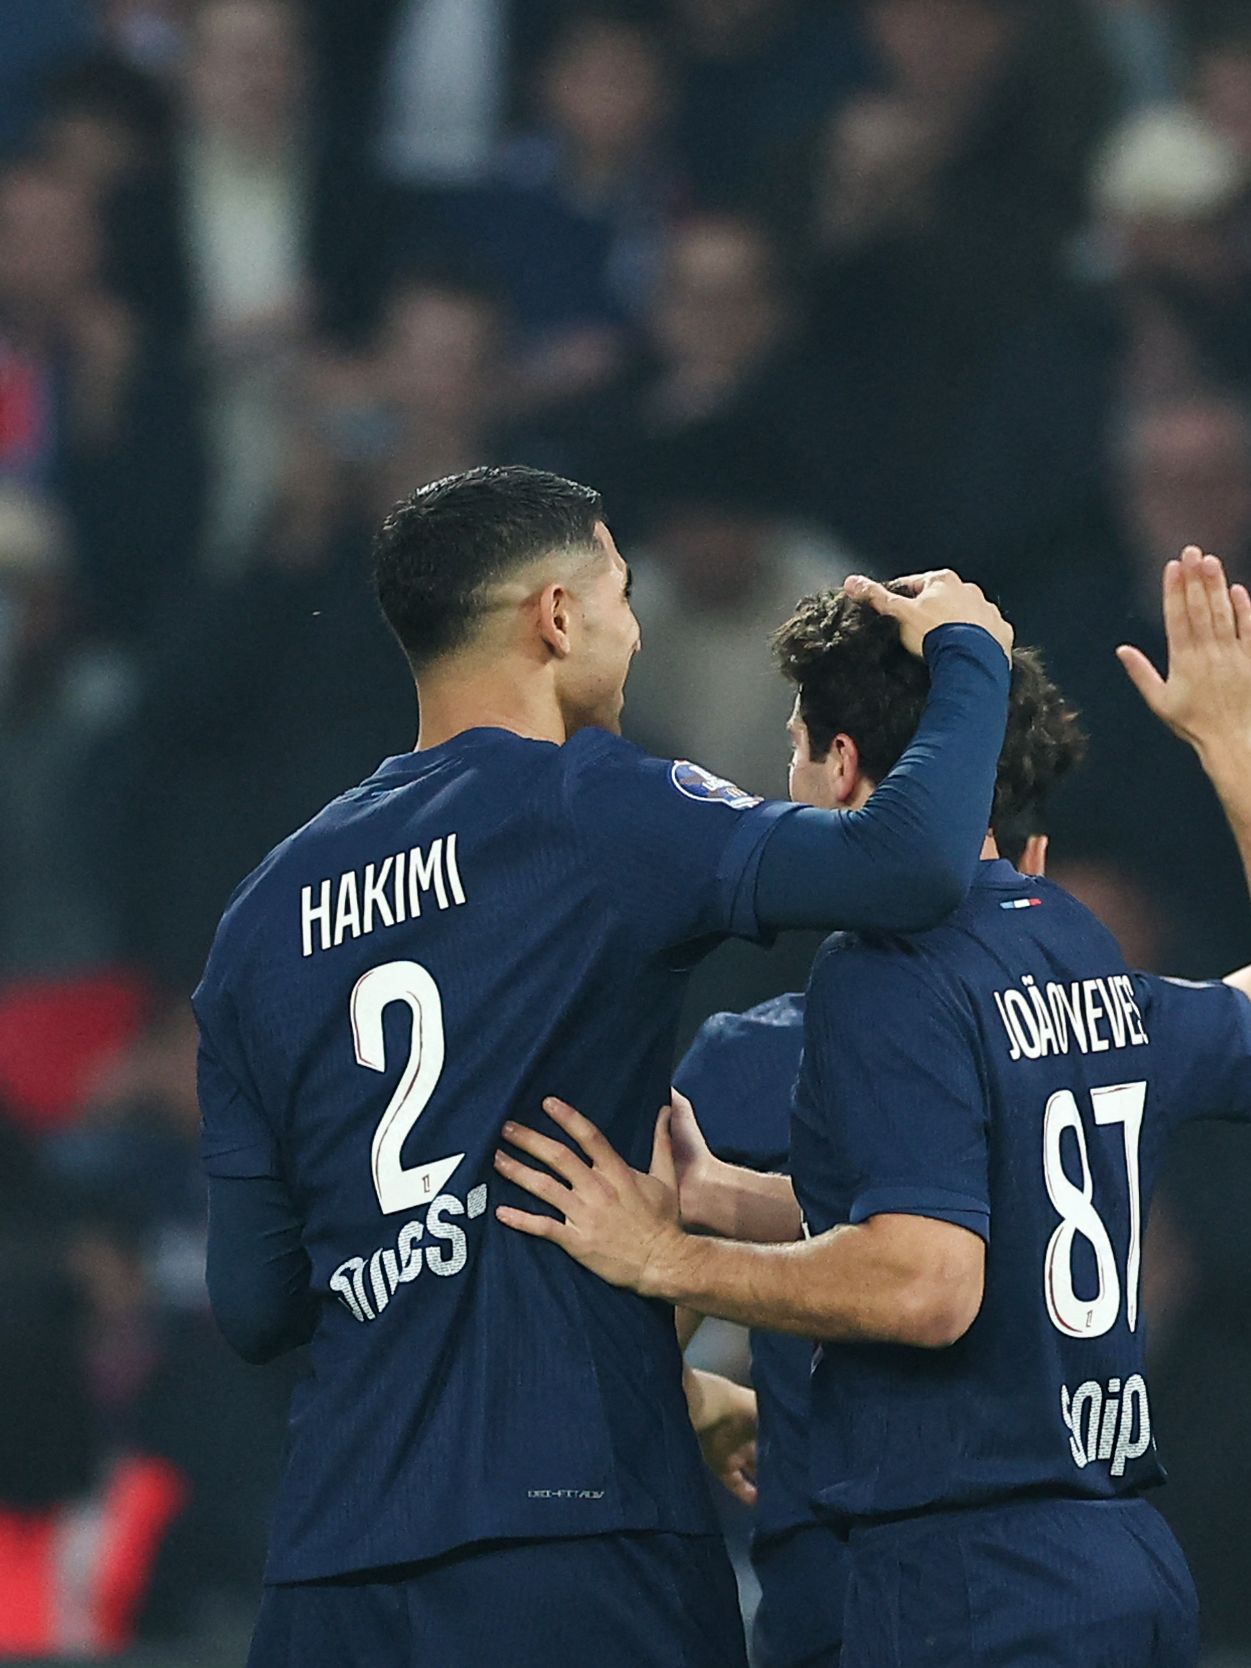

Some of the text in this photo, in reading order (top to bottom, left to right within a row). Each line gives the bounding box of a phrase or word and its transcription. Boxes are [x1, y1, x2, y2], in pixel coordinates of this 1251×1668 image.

[300, 834, 467, 957] HAKIMI
[349, 960, 465, 1215] 2
[1042, 1081, 1148, 1338] 87
